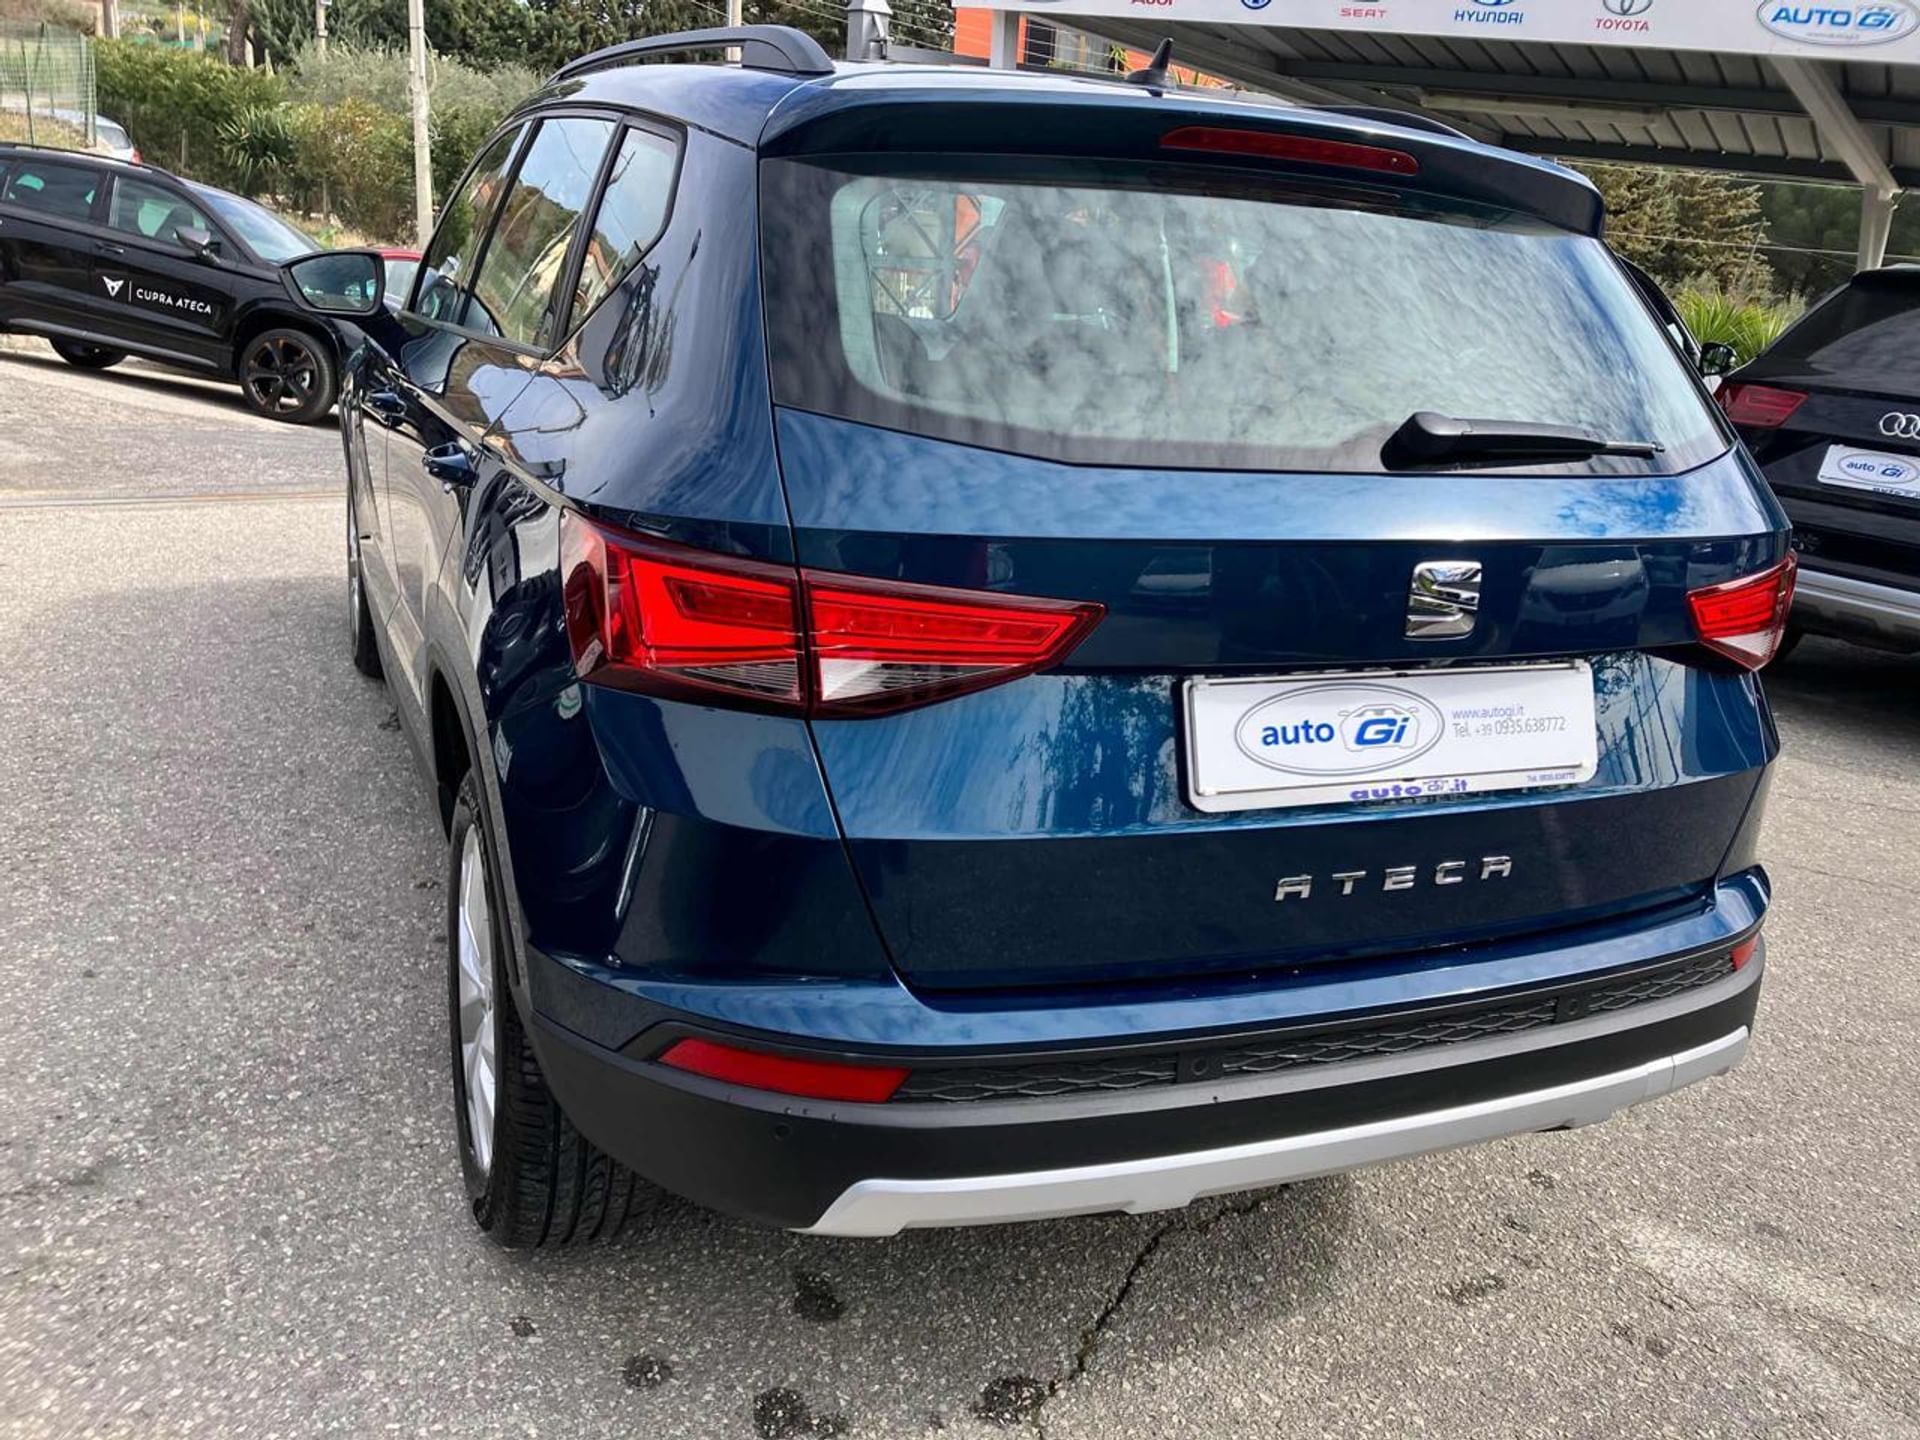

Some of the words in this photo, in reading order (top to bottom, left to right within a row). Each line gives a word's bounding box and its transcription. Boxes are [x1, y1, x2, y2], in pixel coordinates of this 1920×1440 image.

[1340, 7, 1387, 18] SEAT
[1454, 10, 1524, 24] HYUNDAI
[1771, 7, 1851, 26] AUTO
[1596, 18, 1649, 31] TOYOTA
[136, 288, 173, 305] CUPRA
[175, 298, 212, 315] ATECA
[1846, 461, 1876, 472] auto
[1262, 719, 1335, 746] auto
[1354, 717, 1410, 746] Gi
[1274, 856, 1513, 901] ATECA
